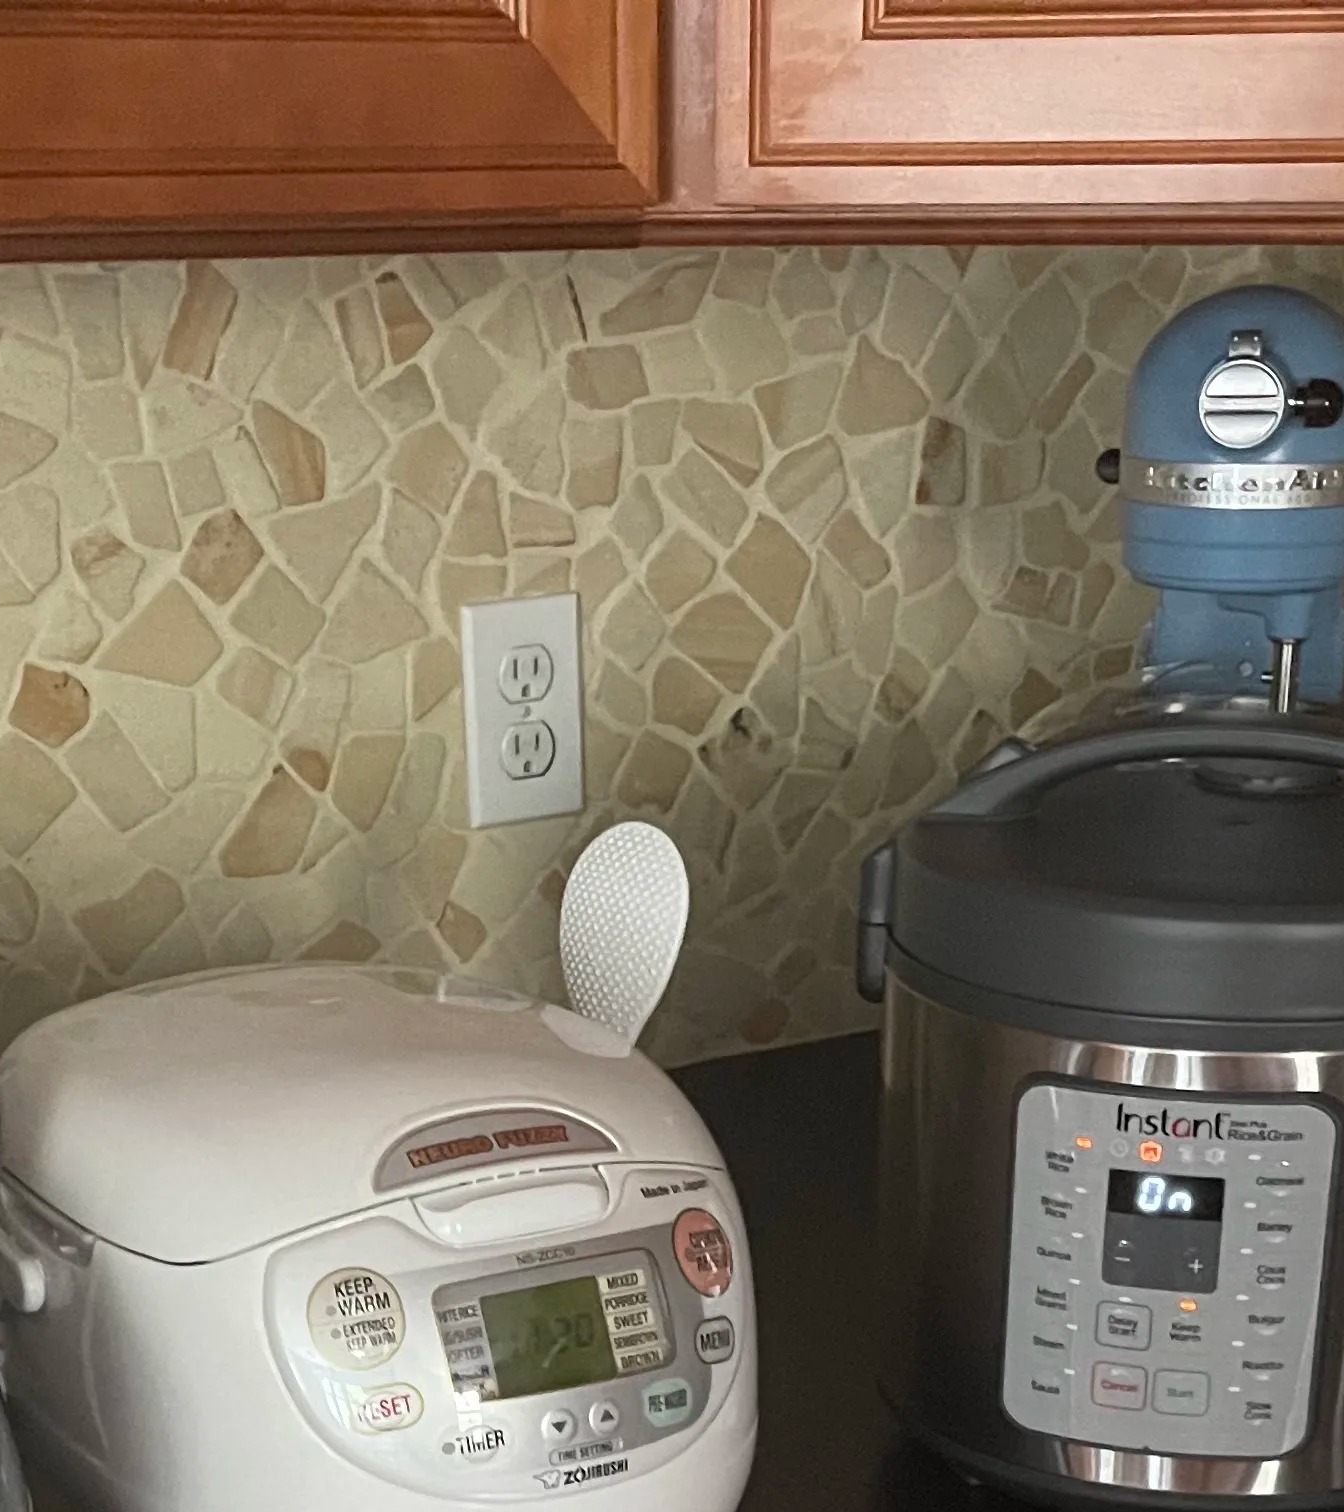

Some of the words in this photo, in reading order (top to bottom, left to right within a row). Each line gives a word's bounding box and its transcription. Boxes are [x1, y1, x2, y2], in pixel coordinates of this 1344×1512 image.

[1116, 1103, 1225, 1139] Instant
[407, 1135, 493, 1168] NEURO
[334, 1277, 373, 1298] KEEP
[607, 1273, 639, 1289] MIXED
[337, 1293, 391, 1316] WARM
[605, 1293, 648, 1310] PORRIDGE
[343, 1317, 396, 1338] EXTENDED
[613, 1311, 648, 1329] SWEET
[700, 1329, 730, 1351] MENU
[621, 1352, 659, 1369] BROWN
[357, 1394, 411, 1422] RESET
[456, 1430, 506, 1455] TIMER
[563, 1458, 629, 1485] ZOJIRUSHI
